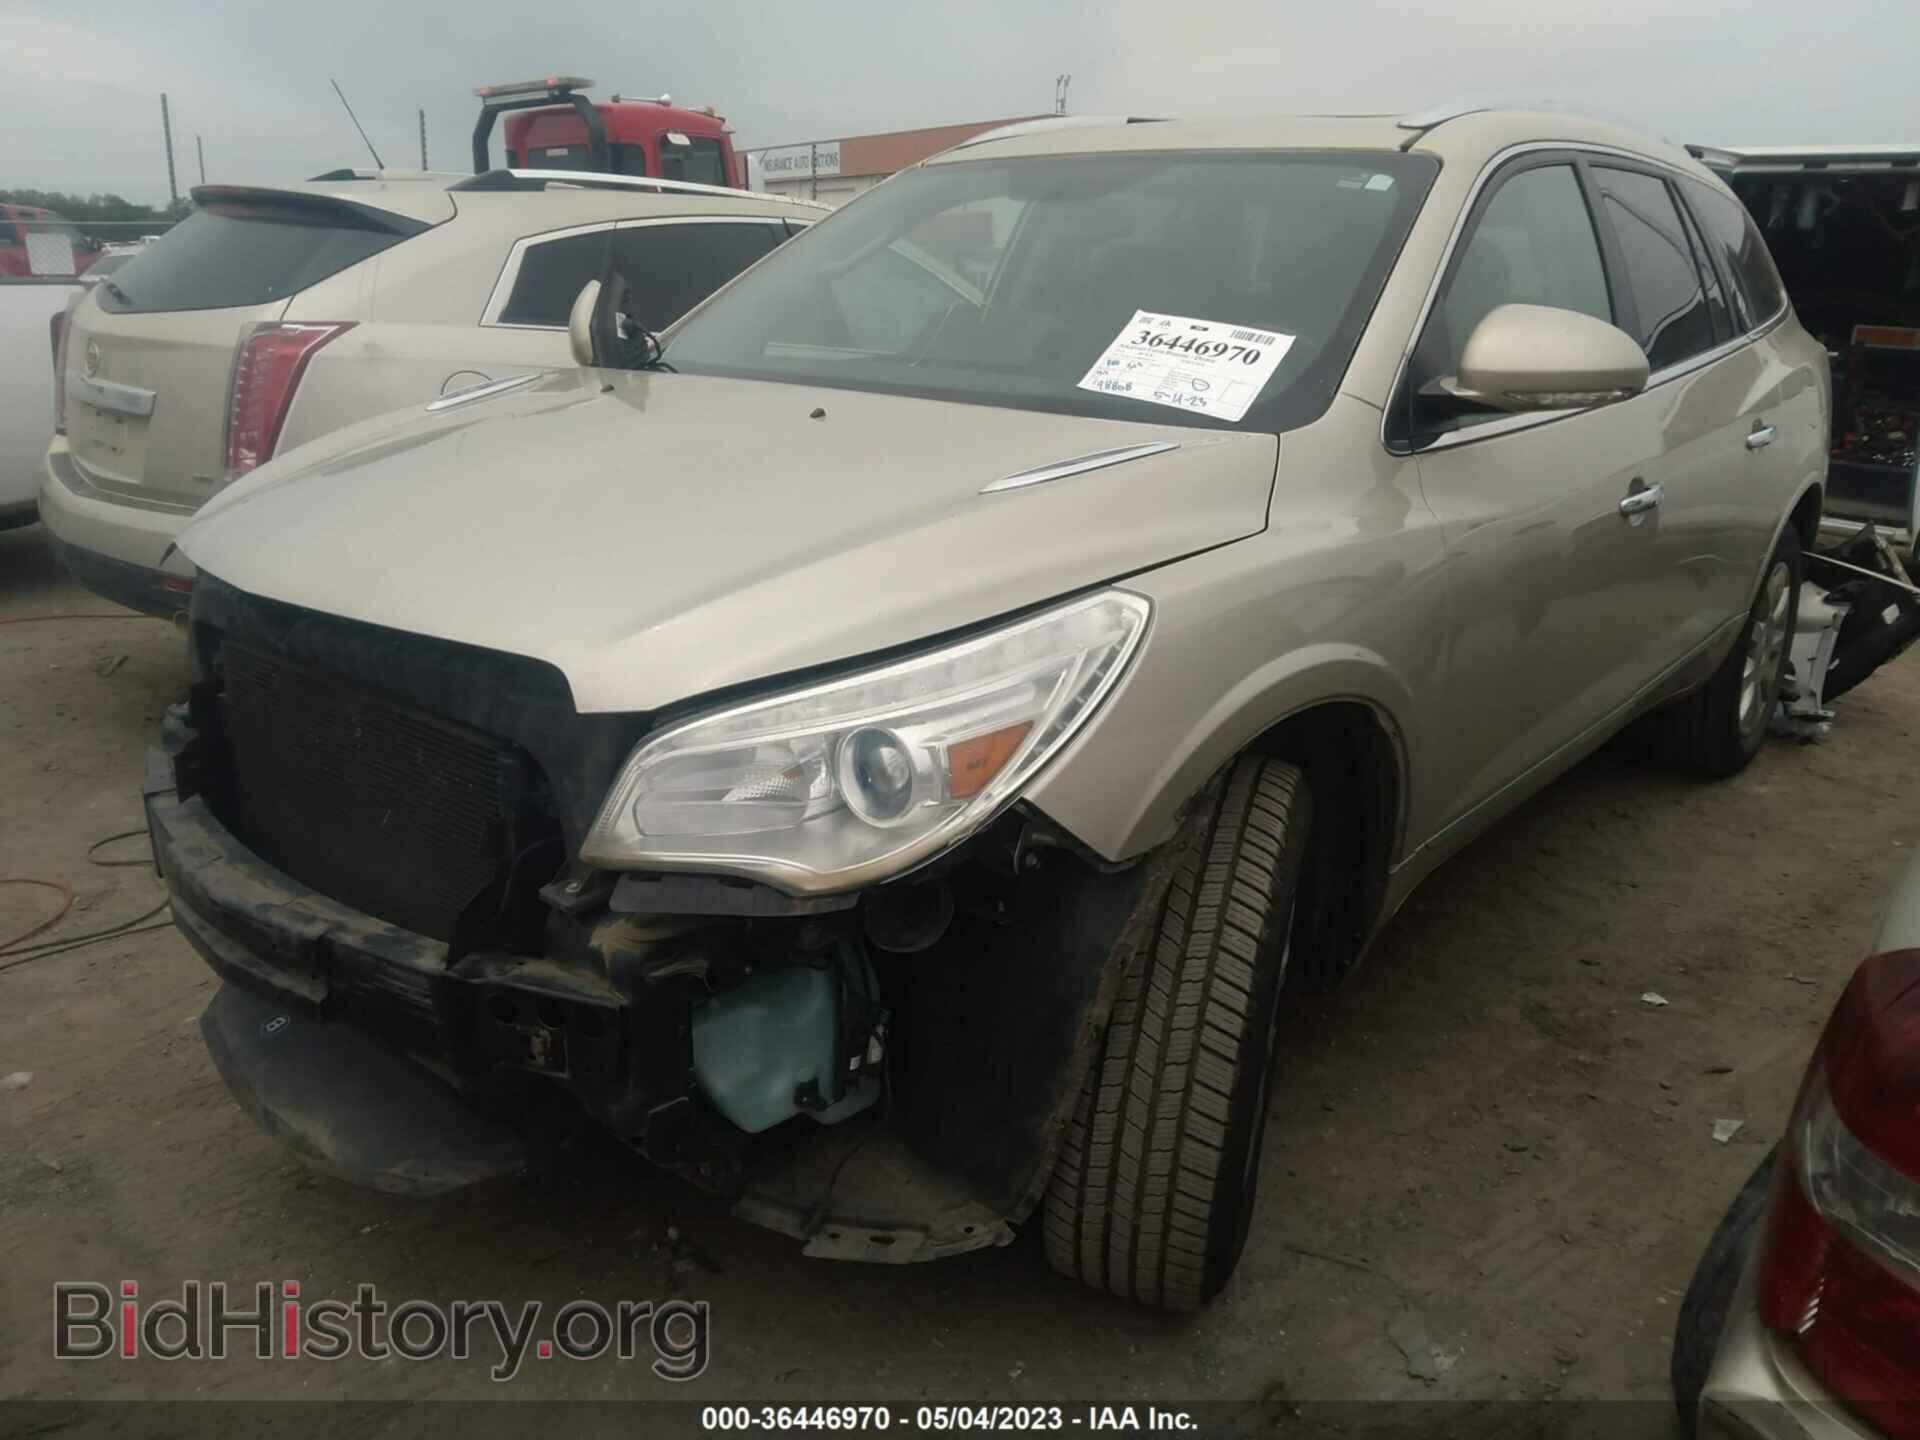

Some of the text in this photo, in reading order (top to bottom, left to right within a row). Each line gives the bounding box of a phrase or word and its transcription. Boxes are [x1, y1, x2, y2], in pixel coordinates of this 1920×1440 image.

[762, 156, 792, 171] NSURANCE
[811, 151, 839, 168] CTIONS
[1131, 330, 1261, 365] 36446970
